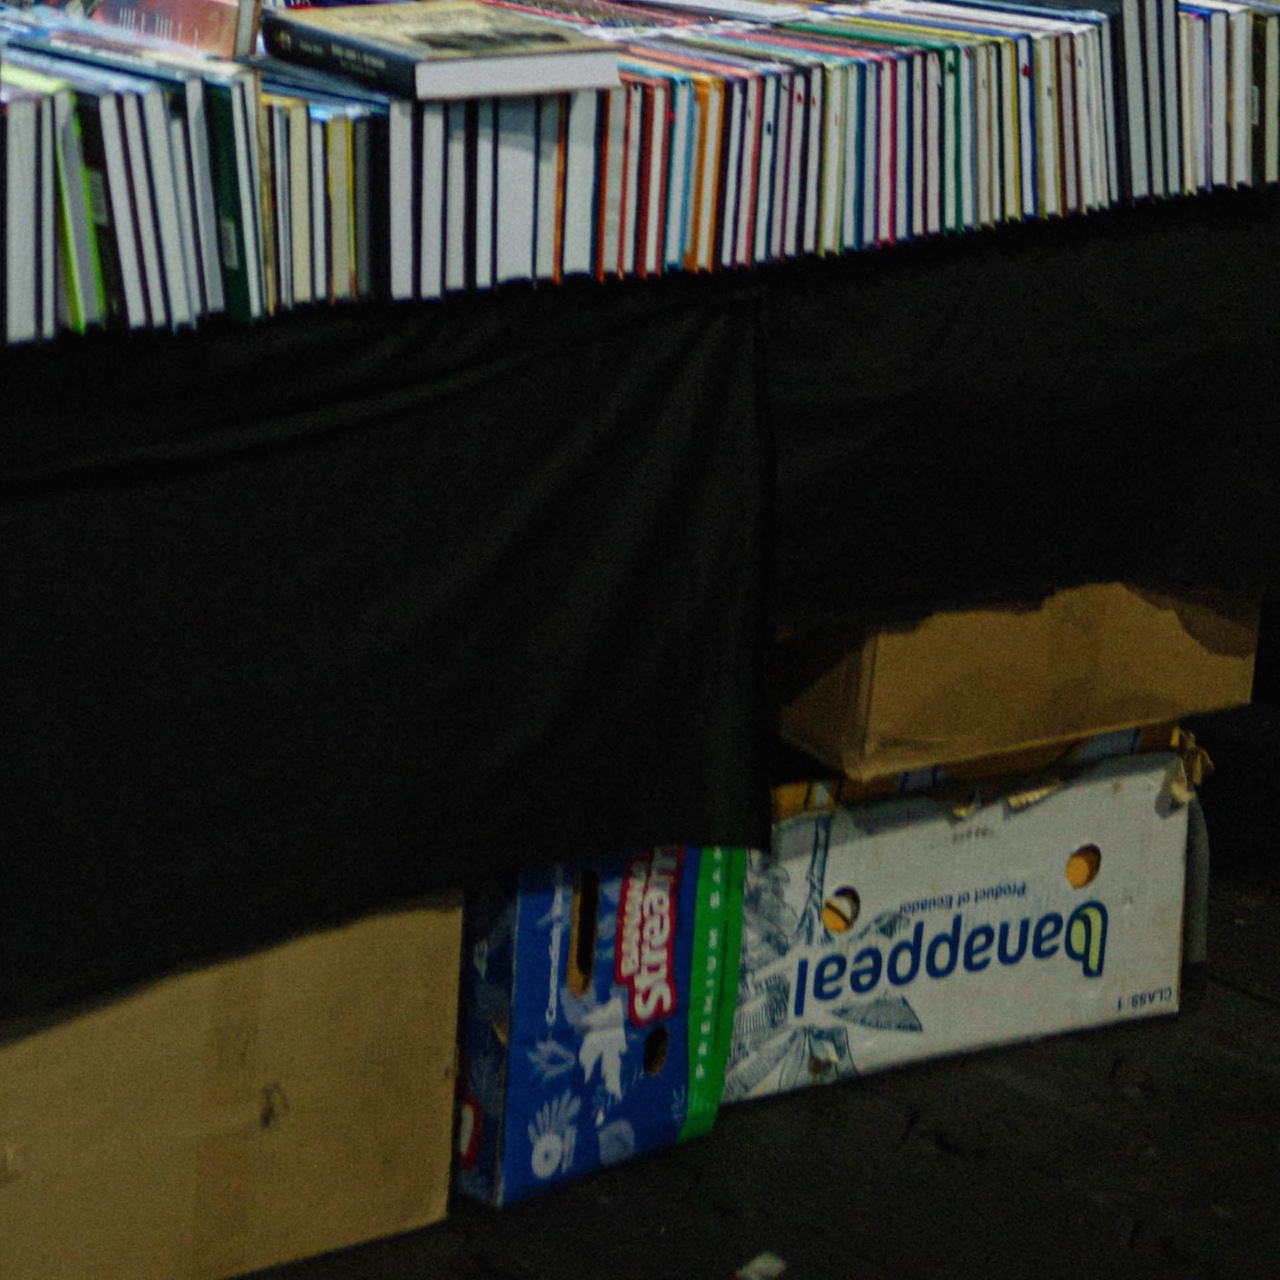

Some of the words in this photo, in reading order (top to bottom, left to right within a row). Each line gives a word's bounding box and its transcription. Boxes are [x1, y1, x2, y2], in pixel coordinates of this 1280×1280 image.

[956, 891, 971, 908] of
[974, 881, 1027, 904] Product
[898, 894, 953, 915] Ecuador
[793, 900, 1109, 1017] banappeal
[695, 928, 718, 1078] PREMIUM
